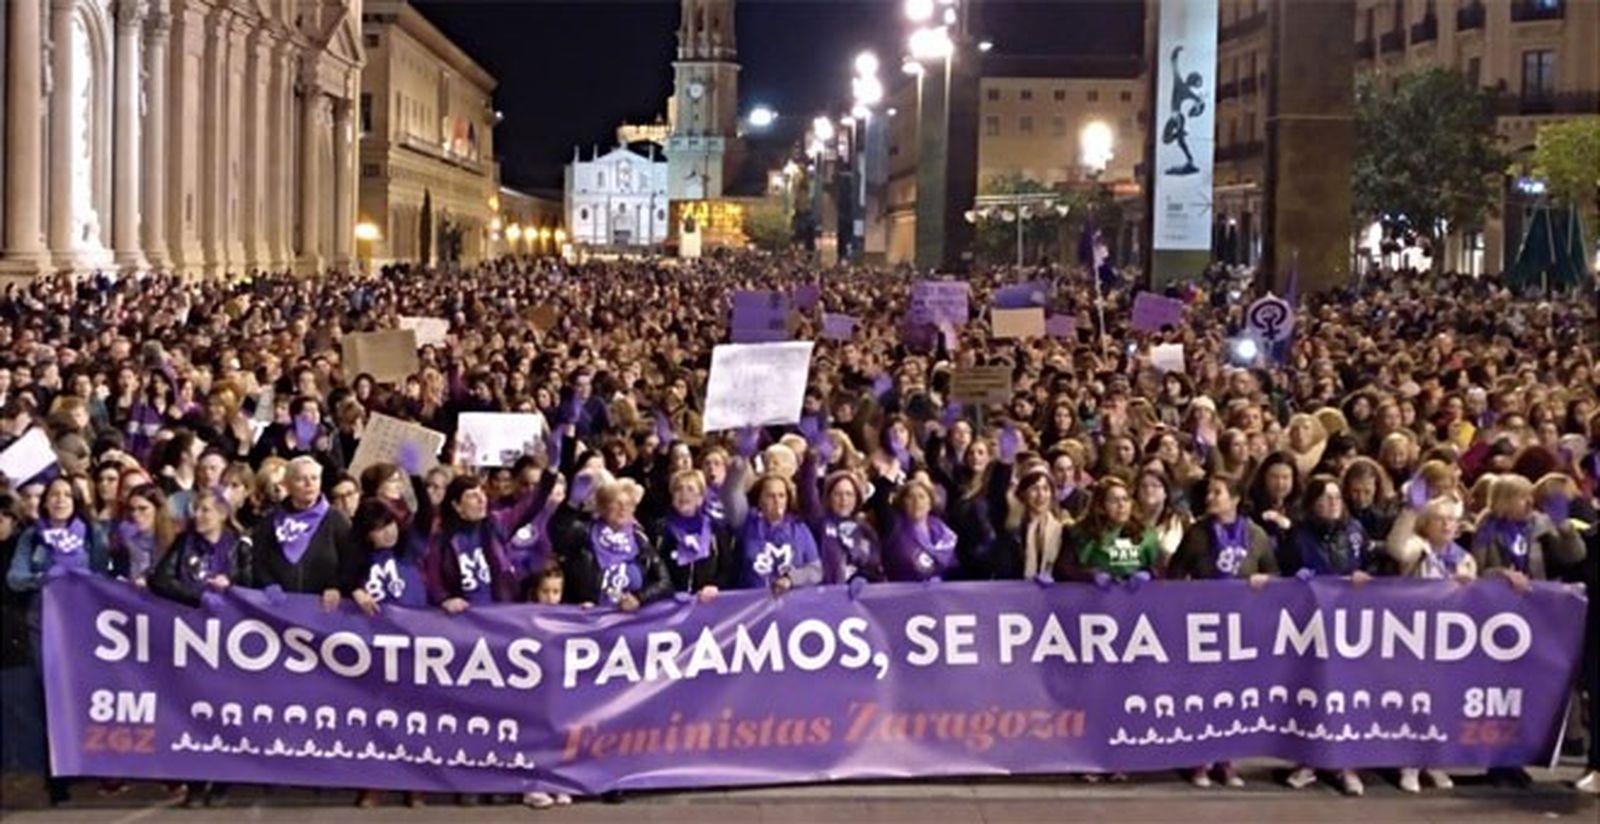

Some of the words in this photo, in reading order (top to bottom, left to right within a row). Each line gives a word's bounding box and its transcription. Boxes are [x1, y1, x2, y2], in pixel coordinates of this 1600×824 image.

[94, 610, 149, 662] SI
[173, 617, 542, 689] NOSOTRAS
[563, 616, 890, 690] PARAMOS,
[905, 613, 979, 666] SE
[998, 612, 1169, 664] PARA
[1186, 612, 1258, 663] EL
[1273, 608, 1532, 661] MUNDO
[89, 689, 157, 724] 8M
[1462, 687, 1523, 718] 8M
[561, 708, 832, 762] Feministas
[845, 700, 1086, 751] Zaragoza
